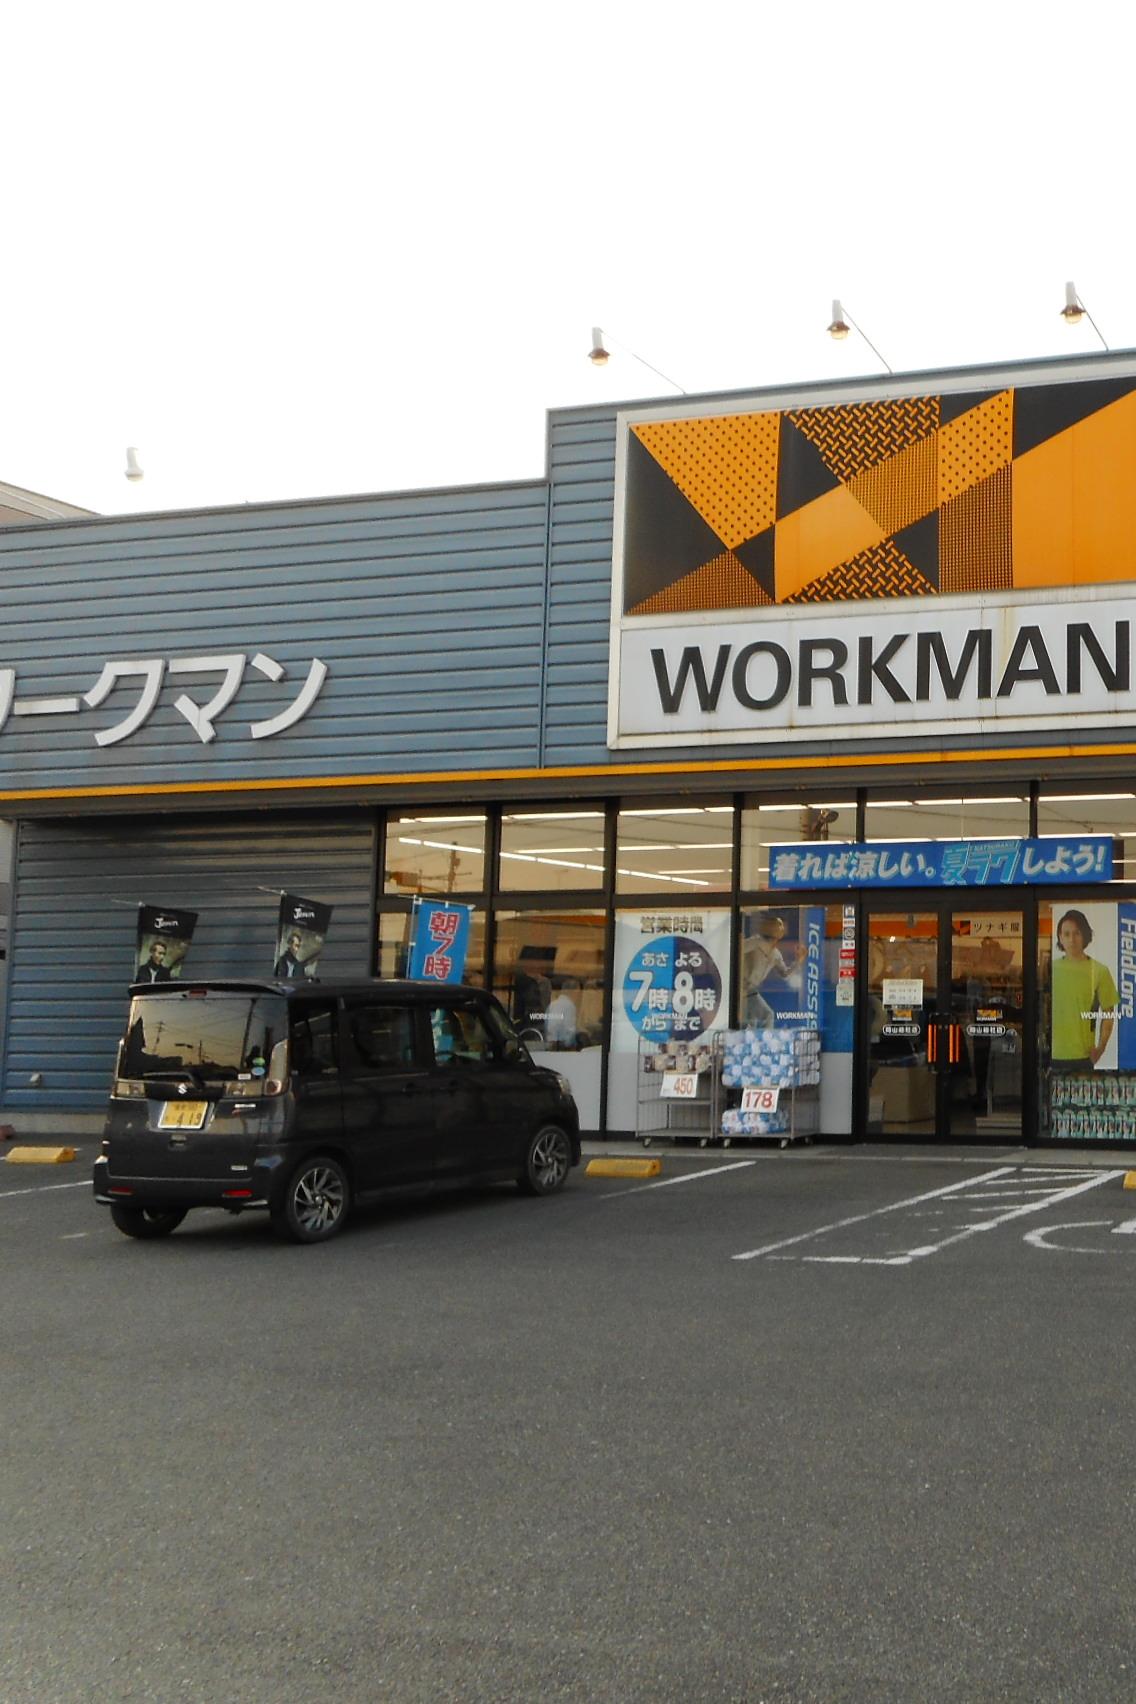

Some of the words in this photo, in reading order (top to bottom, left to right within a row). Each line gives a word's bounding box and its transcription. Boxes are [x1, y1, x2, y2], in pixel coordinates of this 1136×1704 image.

[649, 619, 1130, 715] WORKMAN
[641, 916, 703, 934] 営業時間
[808, 922, 820, 960] ICE
[642, 952, 669, 967] あさ
[675, 952, 702, 967] よる
[629, 971, 669, 1012] 7時
[672, 971, 716, 1014] 8時
[1080, 1011, 1122, 1020] WORKMAN
[673, 1077, 693, 1095] 450
[745, 1091, 773, 1109] 178
